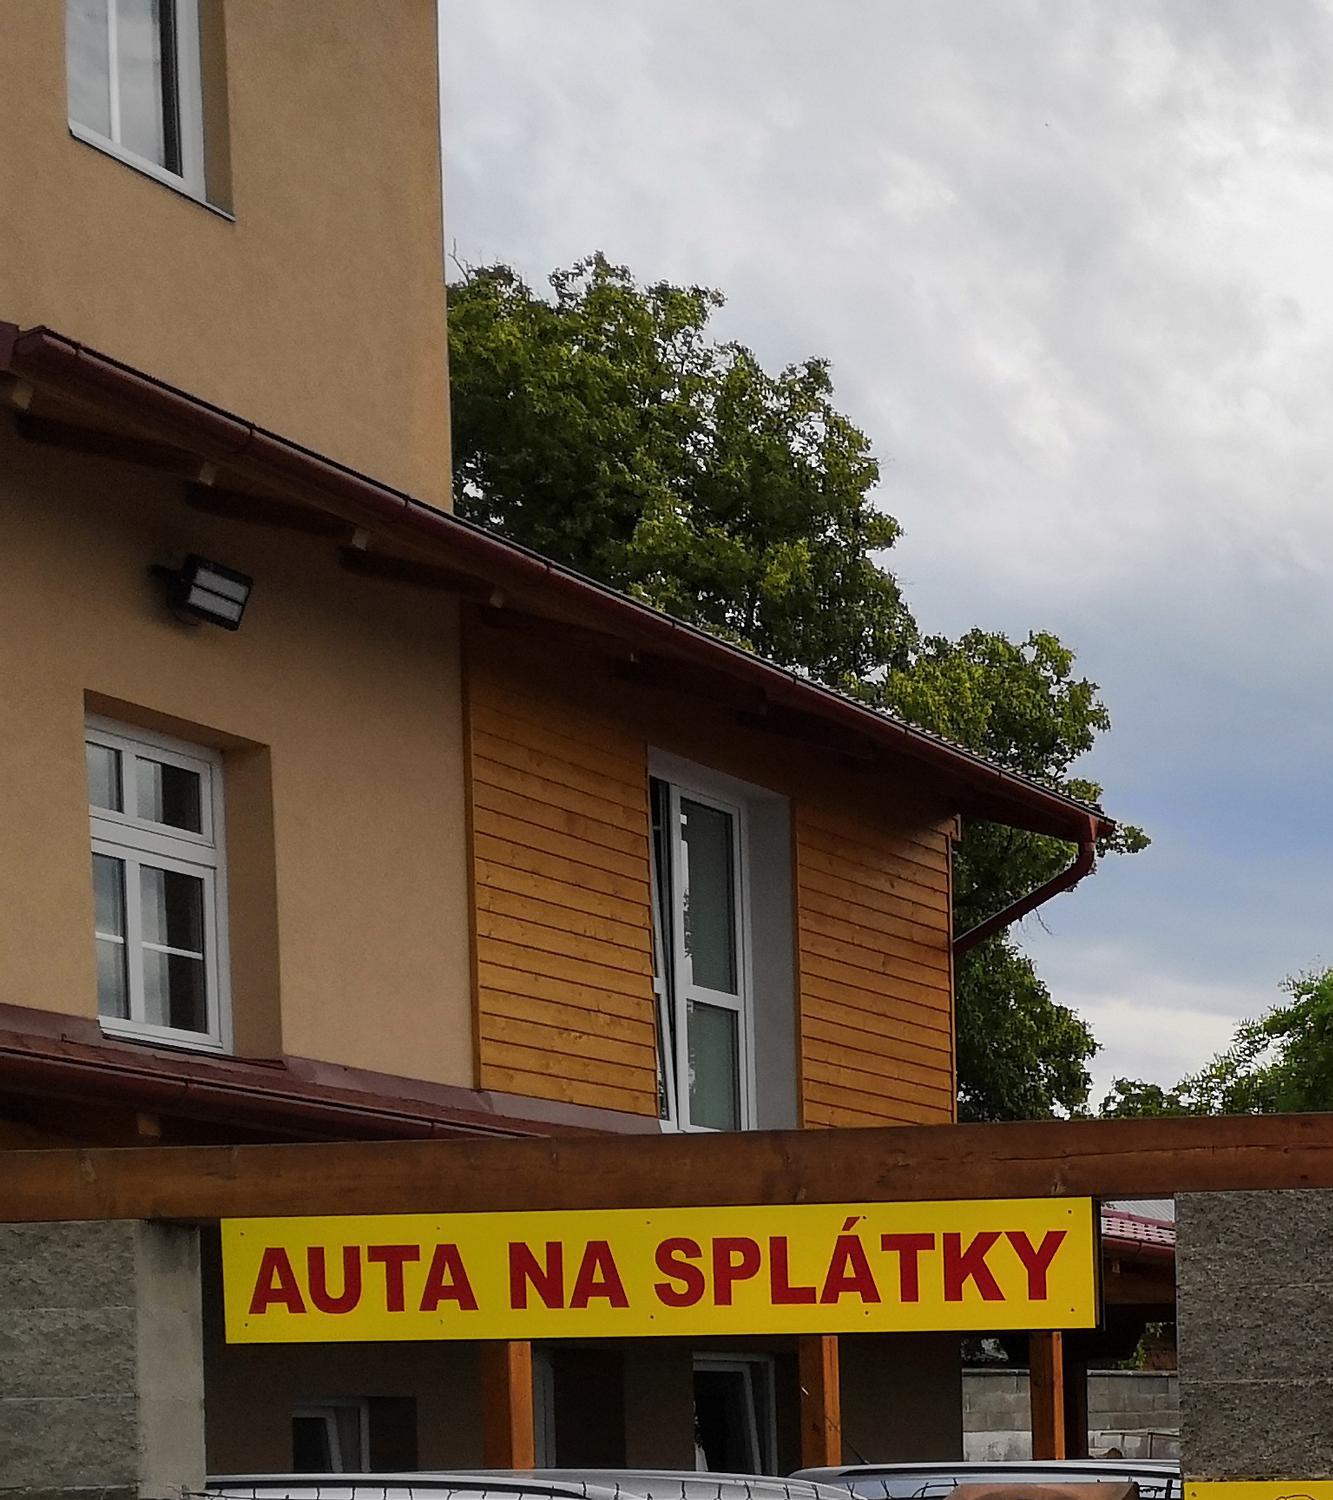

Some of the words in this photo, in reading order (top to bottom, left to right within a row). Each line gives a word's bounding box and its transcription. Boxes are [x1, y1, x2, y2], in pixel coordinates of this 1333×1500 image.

[249, 1246, 479, 1314] AUTA
[509, 1240, 629, 1309] NA
[653, 1216, 1068, 1307] SPLÁTKY
